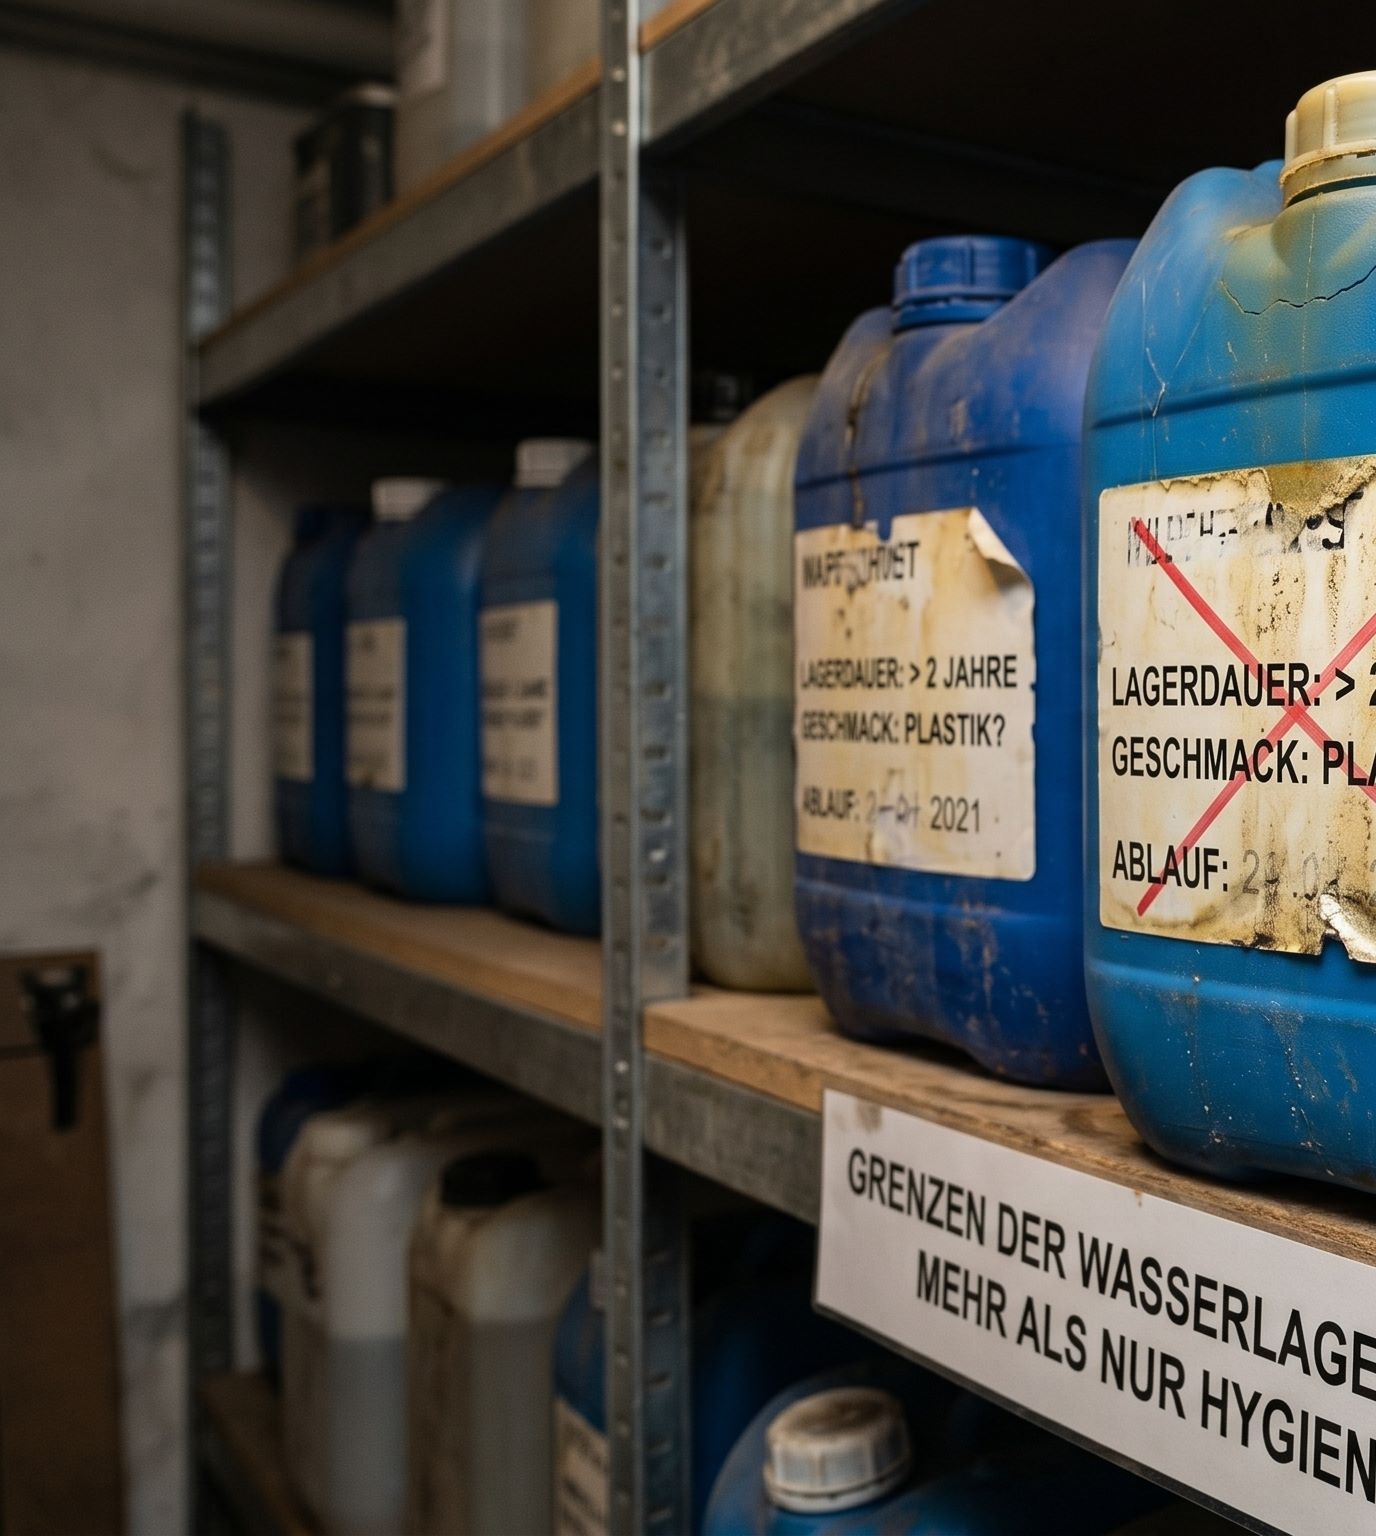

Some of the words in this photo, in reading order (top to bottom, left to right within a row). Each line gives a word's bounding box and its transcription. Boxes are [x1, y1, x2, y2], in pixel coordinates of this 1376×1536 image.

[802, 657, 904, 689] LAGERDAUER:
[910, 663, 921, 683] >
[926, 657, 937, 689] 2
[944, 655, 1018, 689] JAHRE
[1112, 662, 1321, 708] LAGERDAUER:
[1335, 668, 1355, 702] >
[802, 711, 900, 745] GESCHMACK:
[905, 713, 1006, 747] PLASTIK?
[1112, 736, 1309, 785] GESCHMACK:
[930, 795, 981, 834] 2021
[1112, 840, 1229, 892] ABLAUF:
[847, 1147, 987, 1246] GRENZEN
[999, 1205, 1067, 1280] DER
[916, 1249, 1006, 1334] MEHR
[1017, 1295, 1087, 1373] ALS
[1101, 1328, 1185, 1420] NUR
